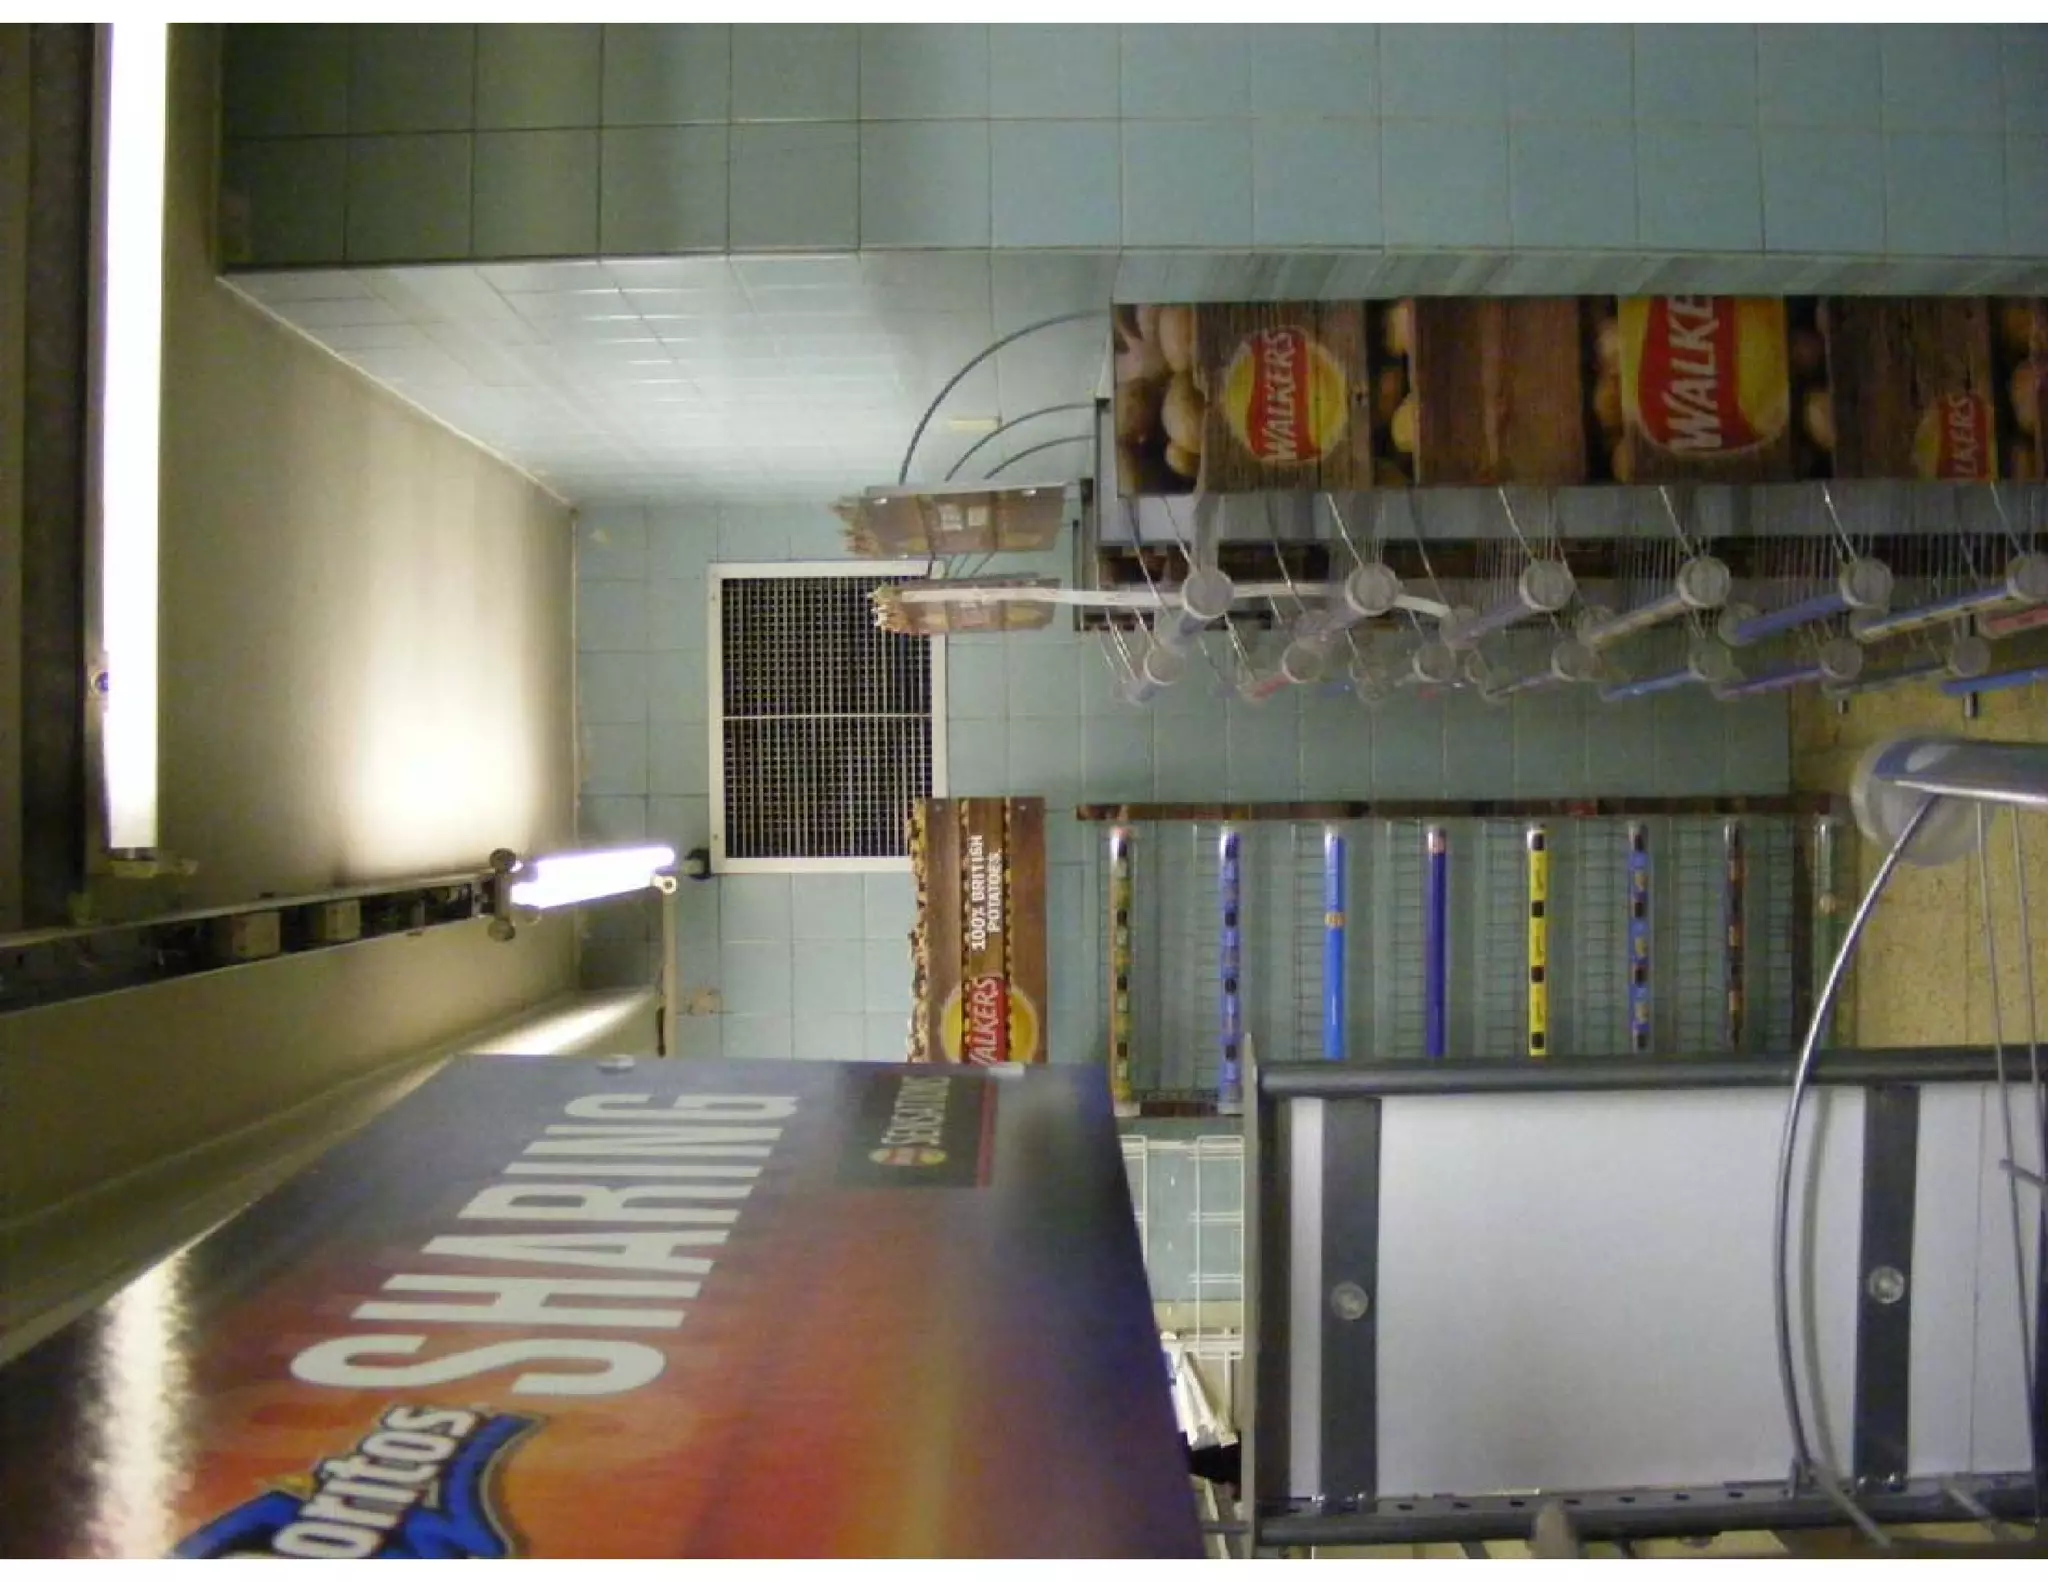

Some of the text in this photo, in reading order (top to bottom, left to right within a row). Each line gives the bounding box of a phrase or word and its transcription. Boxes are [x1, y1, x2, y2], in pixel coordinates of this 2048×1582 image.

[1262, 329, 1297, 460] WALKERS
[1947, 392, 1977, 480] LKERS
[968, 834, 986, 951] 100% BRITISH
[289, 1094, 798, 1395] SHARING
[266, 1406, 478, 1558] oritos
